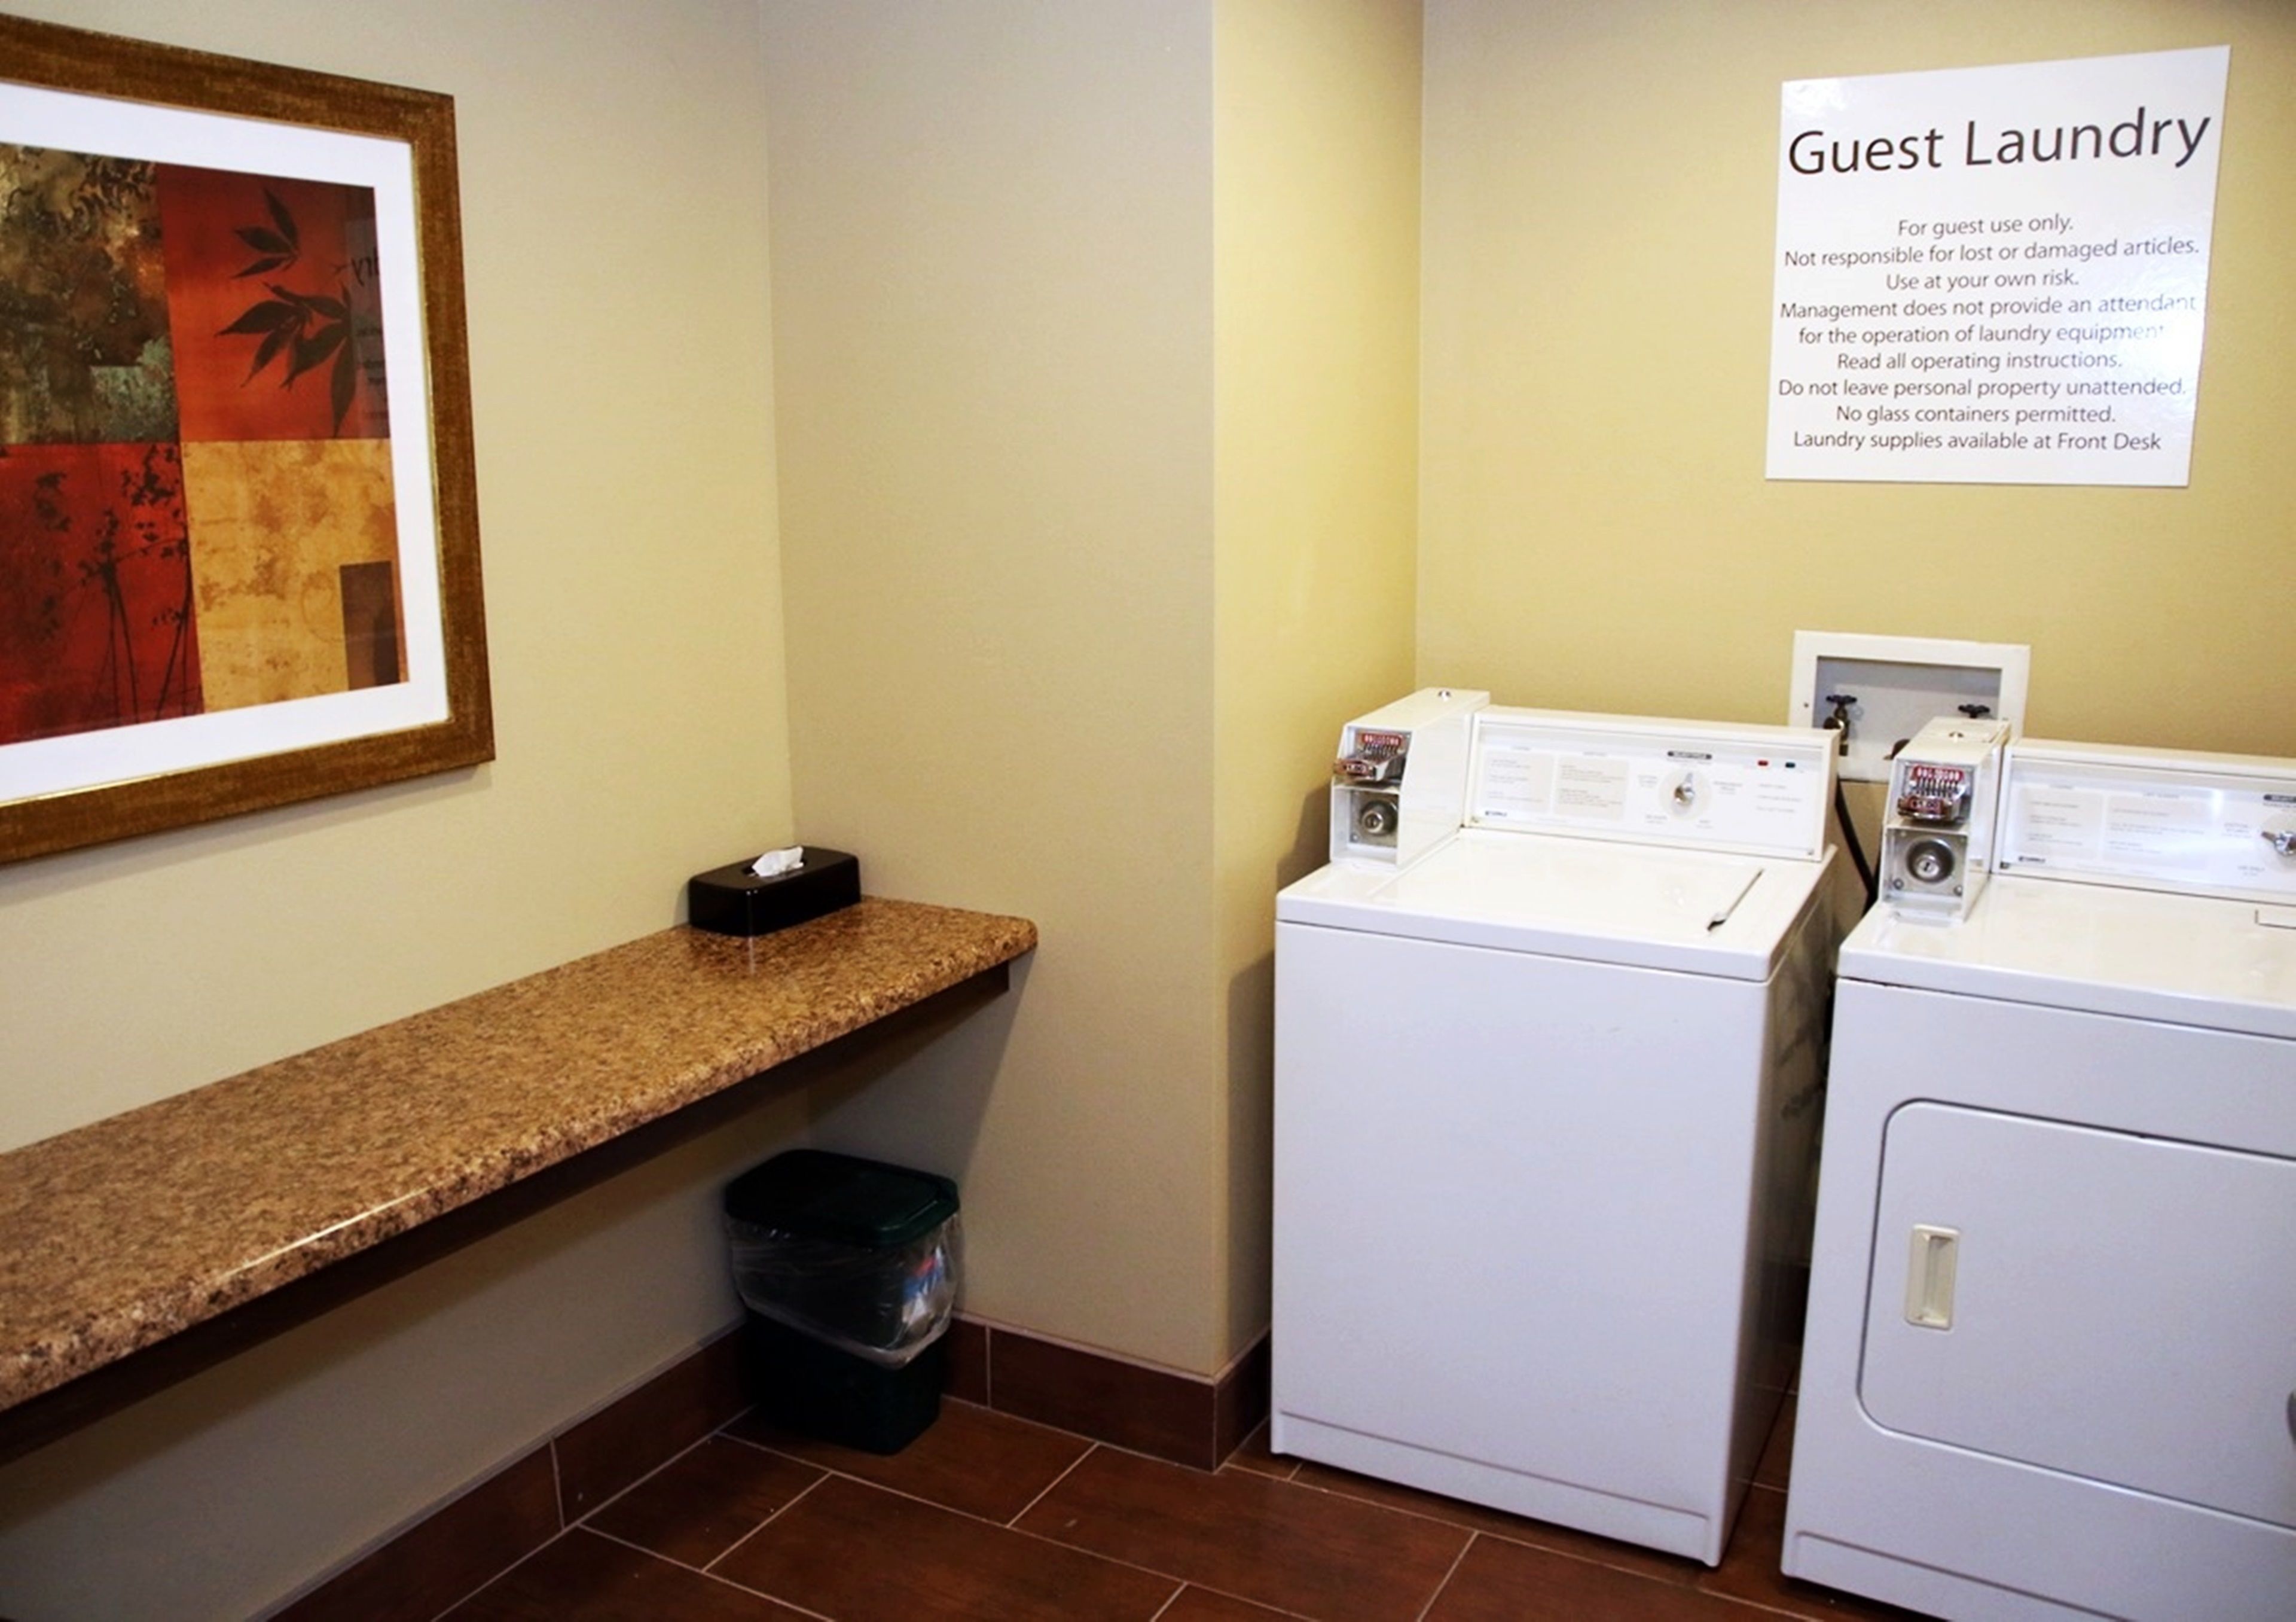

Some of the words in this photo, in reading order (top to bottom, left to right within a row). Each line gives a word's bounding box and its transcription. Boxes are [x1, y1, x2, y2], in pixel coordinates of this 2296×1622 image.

[1789, 128, 1944, 175] Guest
[1966, 106, 2211, 168] Laundry
[1898, 219, 1928, 237] For
[1932, 219, 1984, 240] guest
[1990, 219, 2023, 233] use
[2028, 213, 2074, 235] only.
[1785, 251, 1816, 267] Not
[1821, 246, 1924, 268] responsible
[1929, 244, 1955, 263] for
[1960, 244, 1993, 261] lost
[1999, 246, 2020, 261] or
[2023, 238, 2118, 263] damaged
[2123, 236, 2200, 257] articles.
[1886, 273, 1919, 291] Use
[1923, 275, 1942, 289] at
[1947, 275, 1990, 293] your
[1995, 273, 2037, 288] own
[2042, 267, 2079, 286] risk.
[1780, 302, 1898, 322] Management
[1904, 299, 1947, 316] does
[1953, 300, 1984, 316] not
[1989, 295, 2063, 319] provide
[2068, 300, 2092, 313] an
[2098, 293, 2197, 313] attendant
[1799, 327, 1824, 344] for
[1828, 327, 1857, 344] the
[1861, 326, 1950, 347] operation
[1954, 324, 1976, 342] of
[1979, 324, 2051, 346] laundry
[1837, 352, 1882, 370] Read
[1886, 352, 1906, 370] all
[1910, 352, 2001, 373] operating
[2006, 352, 2123, 369] instructions.
[1778, 379, 1804, 396] Do
[1808, 382, 1839, 396] not
[1843, 379, 1889, 396] leave
[1894, 378, 1972, 400] personal
[1977, 380, 2062, 400] property
[1836, 405, 1863, 422] No
[1867, 404, 1910, 426] glass
[1915, 406, 2010, 422] containers
[2015, 405, 2116, 426] permitted.
[1794, 430, 1866, 452] Laundry
[1870, 431, 1943, 452] supplies
[1947, 431, 2029, 449] available
[2033, 435, 2052, 449] at
[2057, 432, 2108, 450] Front
[2113, 432, 2161, 451] Desk
